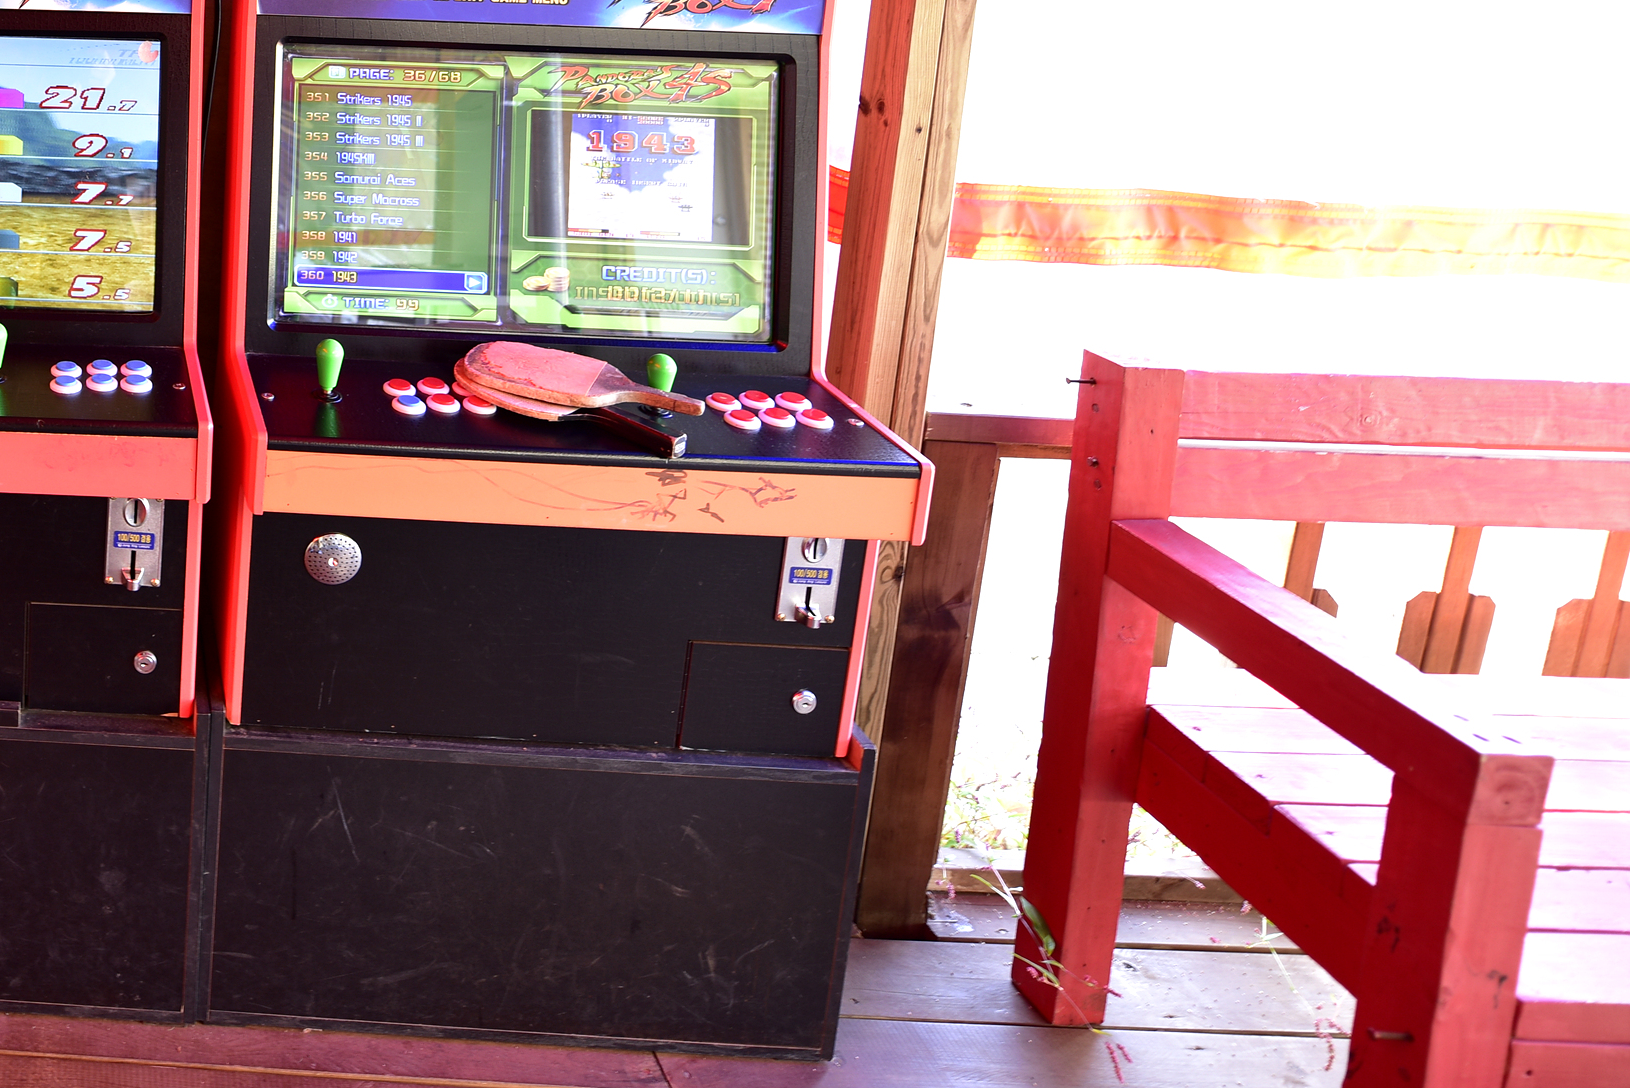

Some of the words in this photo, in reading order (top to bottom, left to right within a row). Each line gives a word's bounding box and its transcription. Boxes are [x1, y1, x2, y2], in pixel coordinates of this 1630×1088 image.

[349, 68, 394, 81] PAGE:
[39, 85, 137, 111] 21.7
[306, 92, 329, 102] 351
[337, 93, 382, 106] Strikers
[306, 112, 329, 122] 352
[336, 113, 381, 126] Strikers
[305, 132, 329, 141] 353
[336, 133, 380, 146] Strikers
[586, 129, 699, 155] 1943
[305, 152, 328, 161] 354
[304, 172, 327, 181] 355
[334, 172, 381, 185] Samurai
[386, 173, 416, 186] Aces
[303, 192, 327, 201] 356
[334, 192, 367, 205] Super
[372, 193, 420, 206] Macross
[303, 211, 326, 220] 357
[334, 211, 366, 224] Turbo
[370, 213, 403, 225] Force
[302, 231, 326, 240] 358
[333, 231, 357, 243] 1941
[301, 251, 325, 260] 359
[333, 251, 358, 263] 1942
[300, 271, 325, 280] 360
[332, 271, 357, 283] 1943
[601, 265, 717, 285] CREDIT(S):
[342, 297, 390, 309] TIME:
[396, 299, 419, 310] 99
